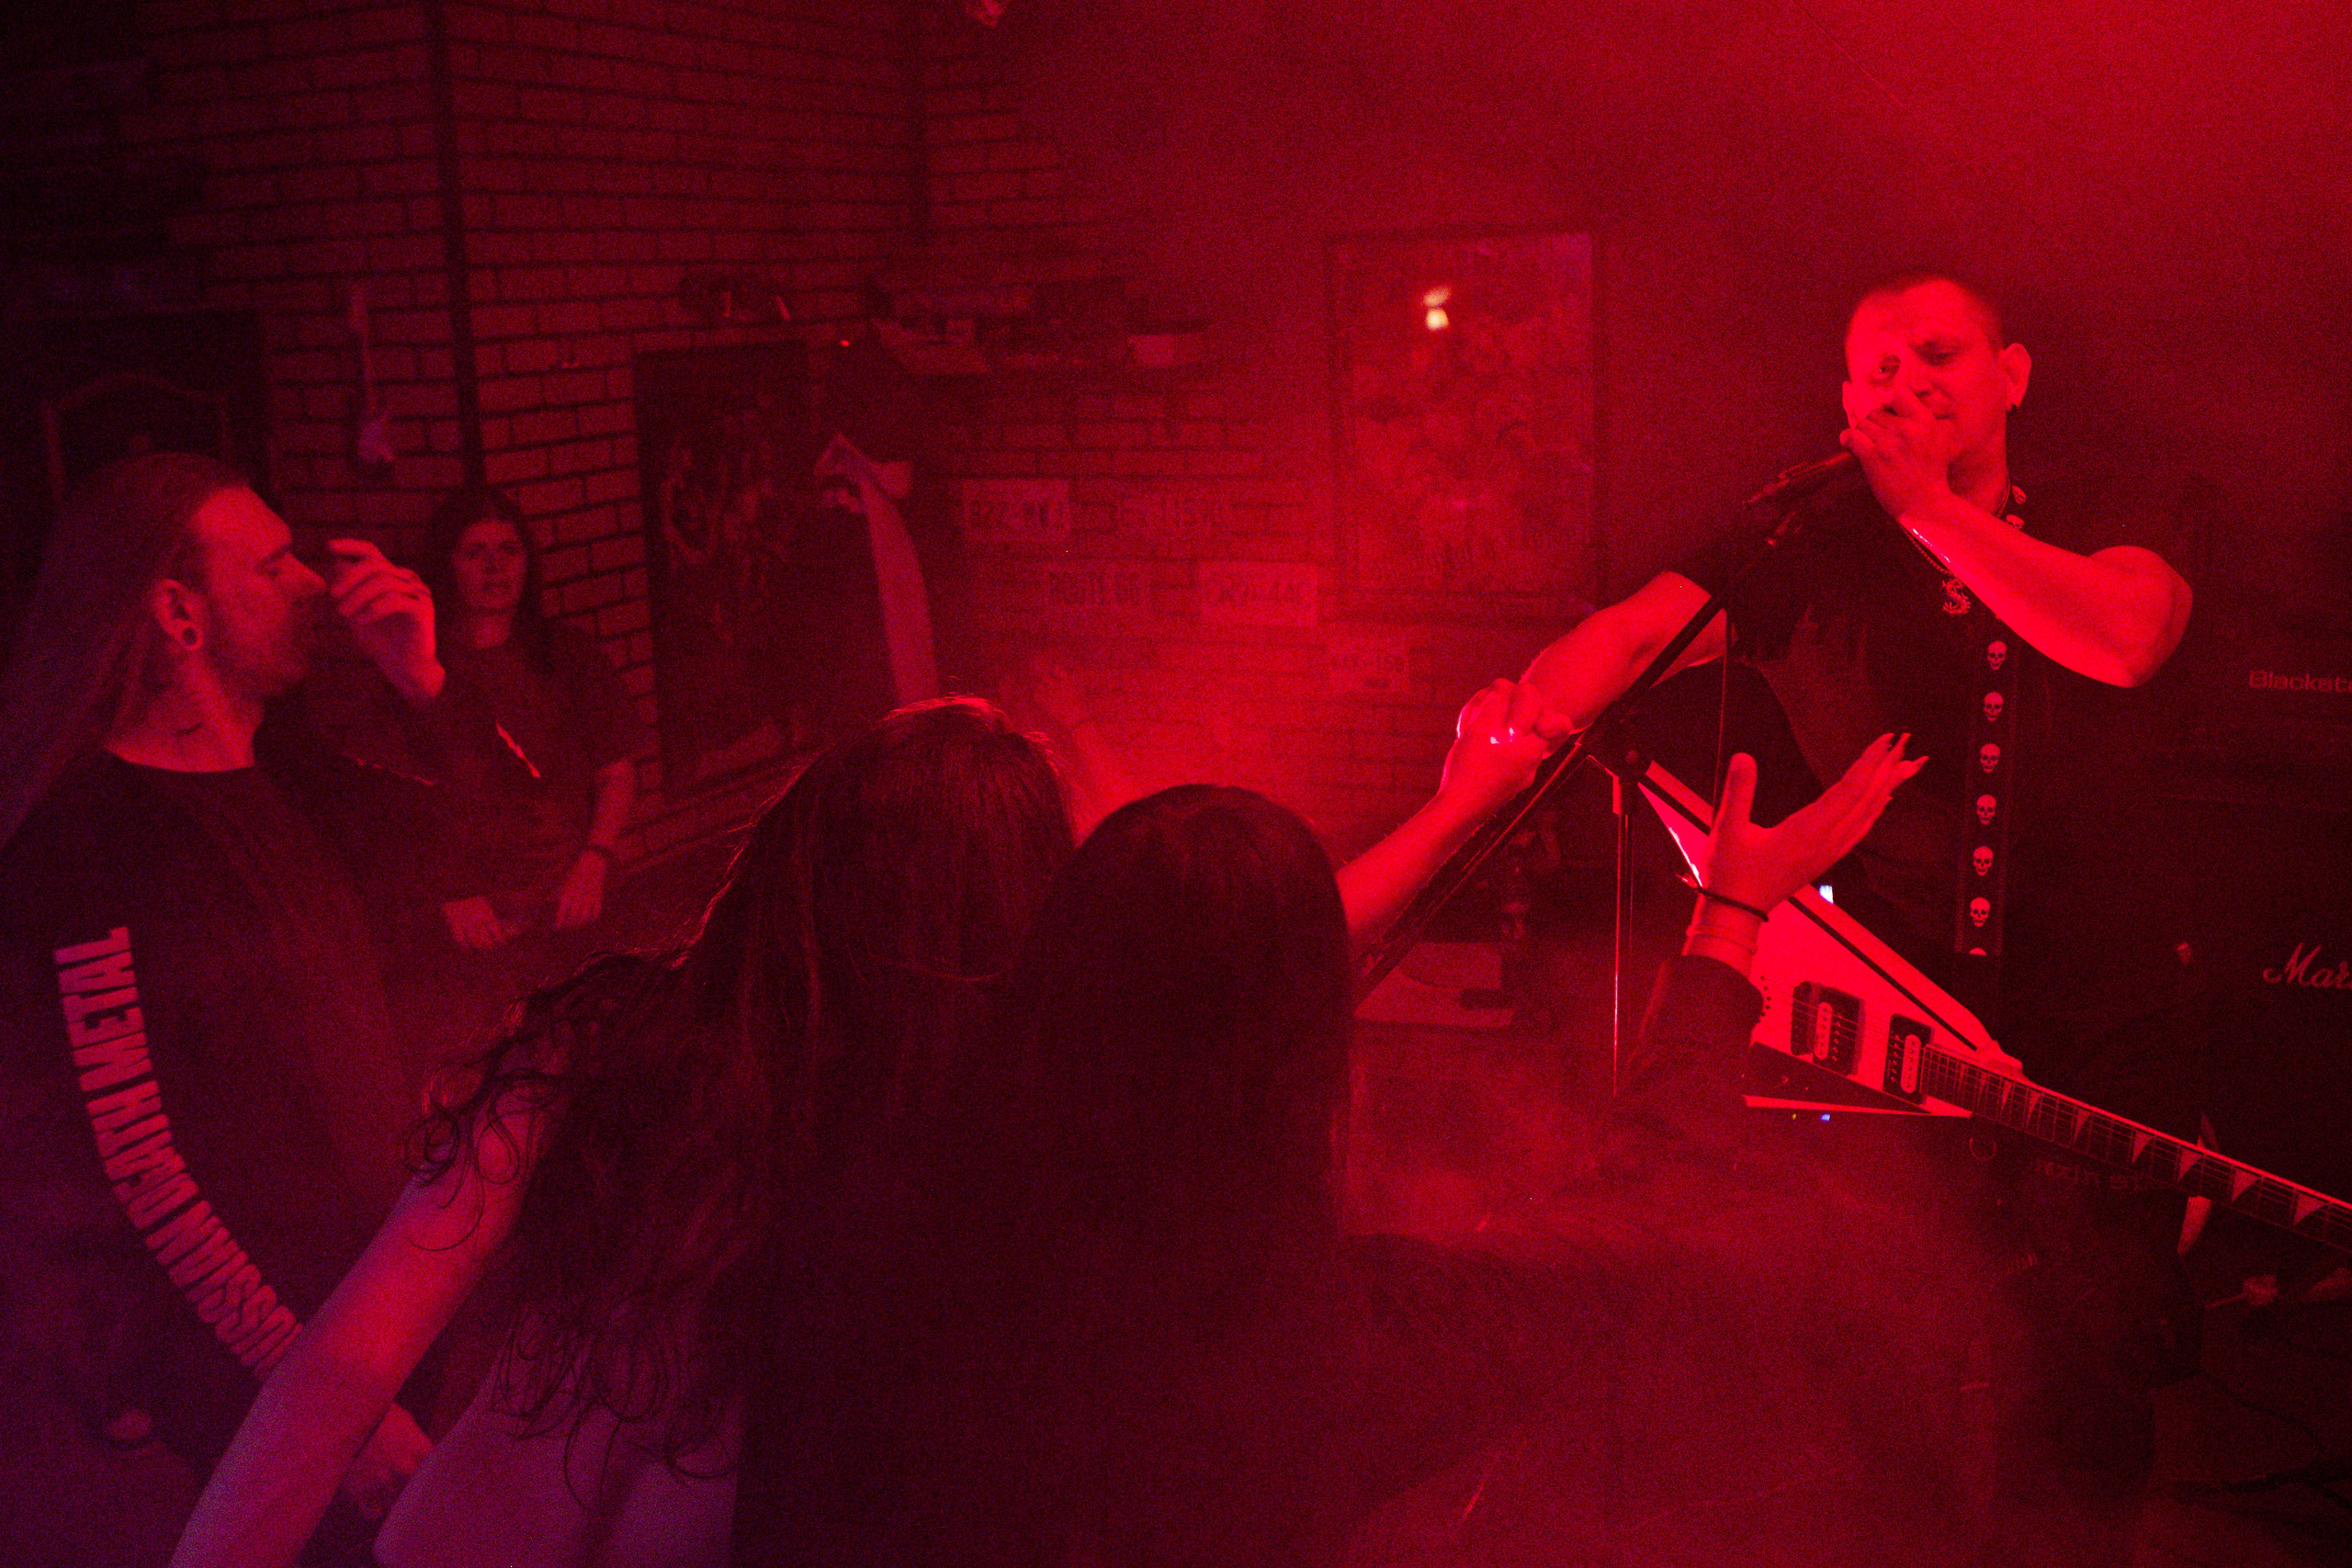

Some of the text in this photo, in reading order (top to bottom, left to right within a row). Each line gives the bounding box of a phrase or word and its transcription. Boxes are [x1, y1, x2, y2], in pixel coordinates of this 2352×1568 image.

[51, 924, 154, 1093] METAL
[2262, 942, 2352, 990] Mar
[85, 1079, 200, 1232] DEATH
